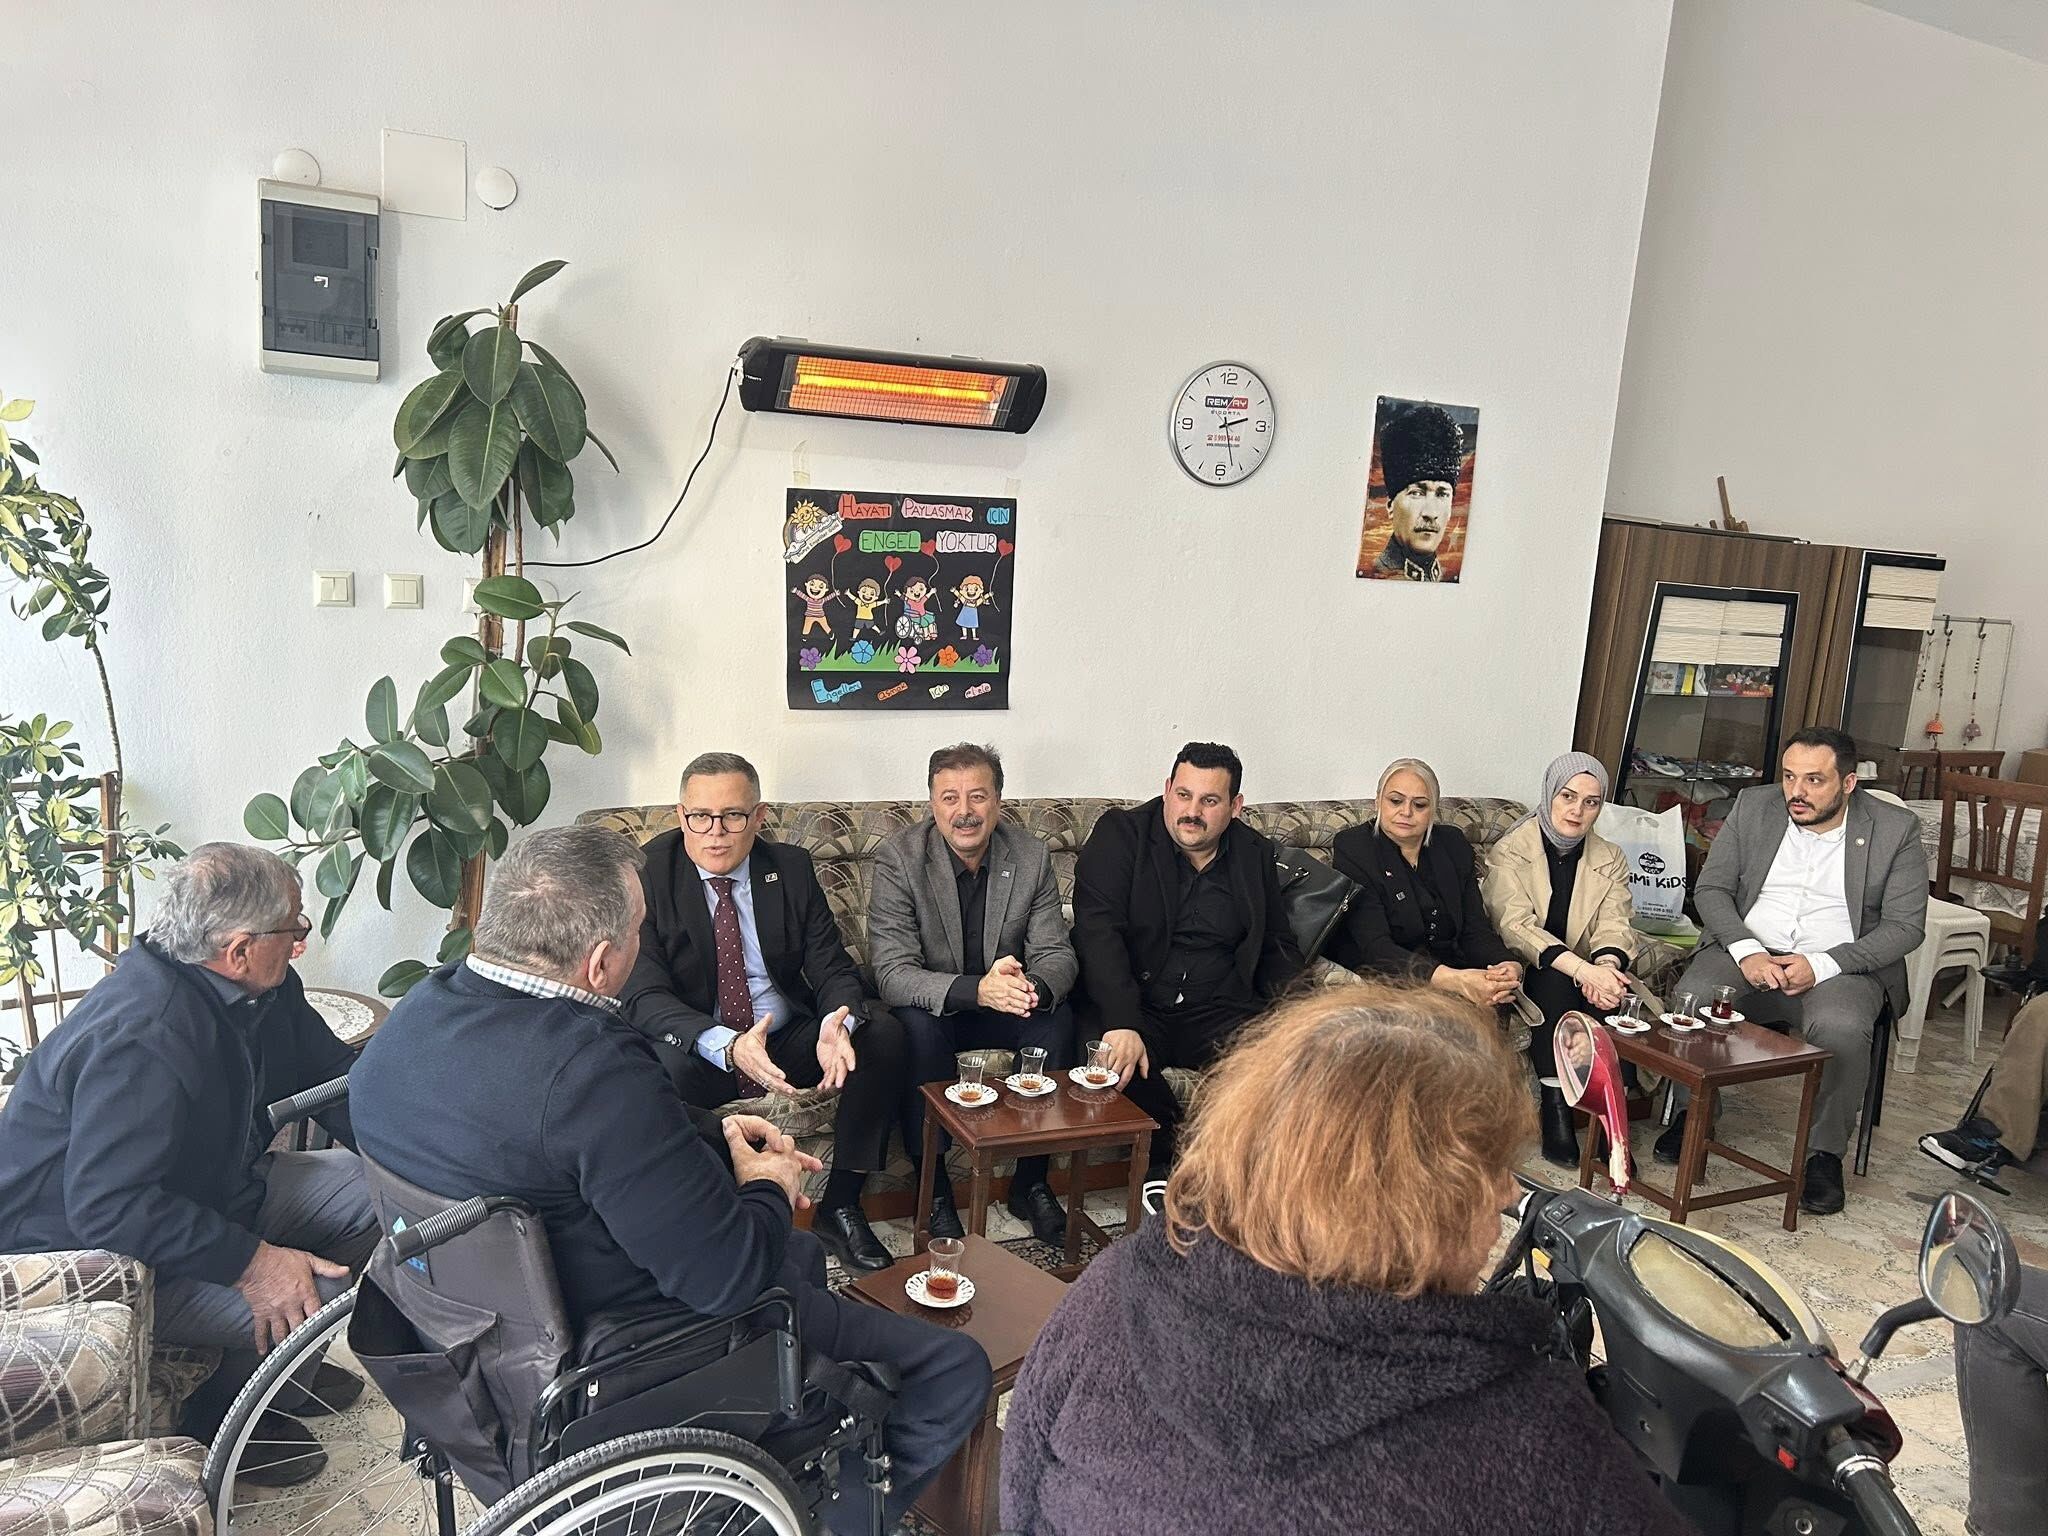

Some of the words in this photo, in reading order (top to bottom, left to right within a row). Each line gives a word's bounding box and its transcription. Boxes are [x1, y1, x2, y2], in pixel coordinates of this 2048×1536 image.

[1220, 372, 1238, 385] 12
[1182, 417, 1194, 430] 9
[1255, 420, 1267, 432] 3
[1215, 464, 1226, 476] 6
[841, 495, 891, 518] HAYATI
[862, 531, 919, 551] ENGEL
[937, 532, 996, 551] YOKTUR
[1629, 872, 1650, 887] iMi
